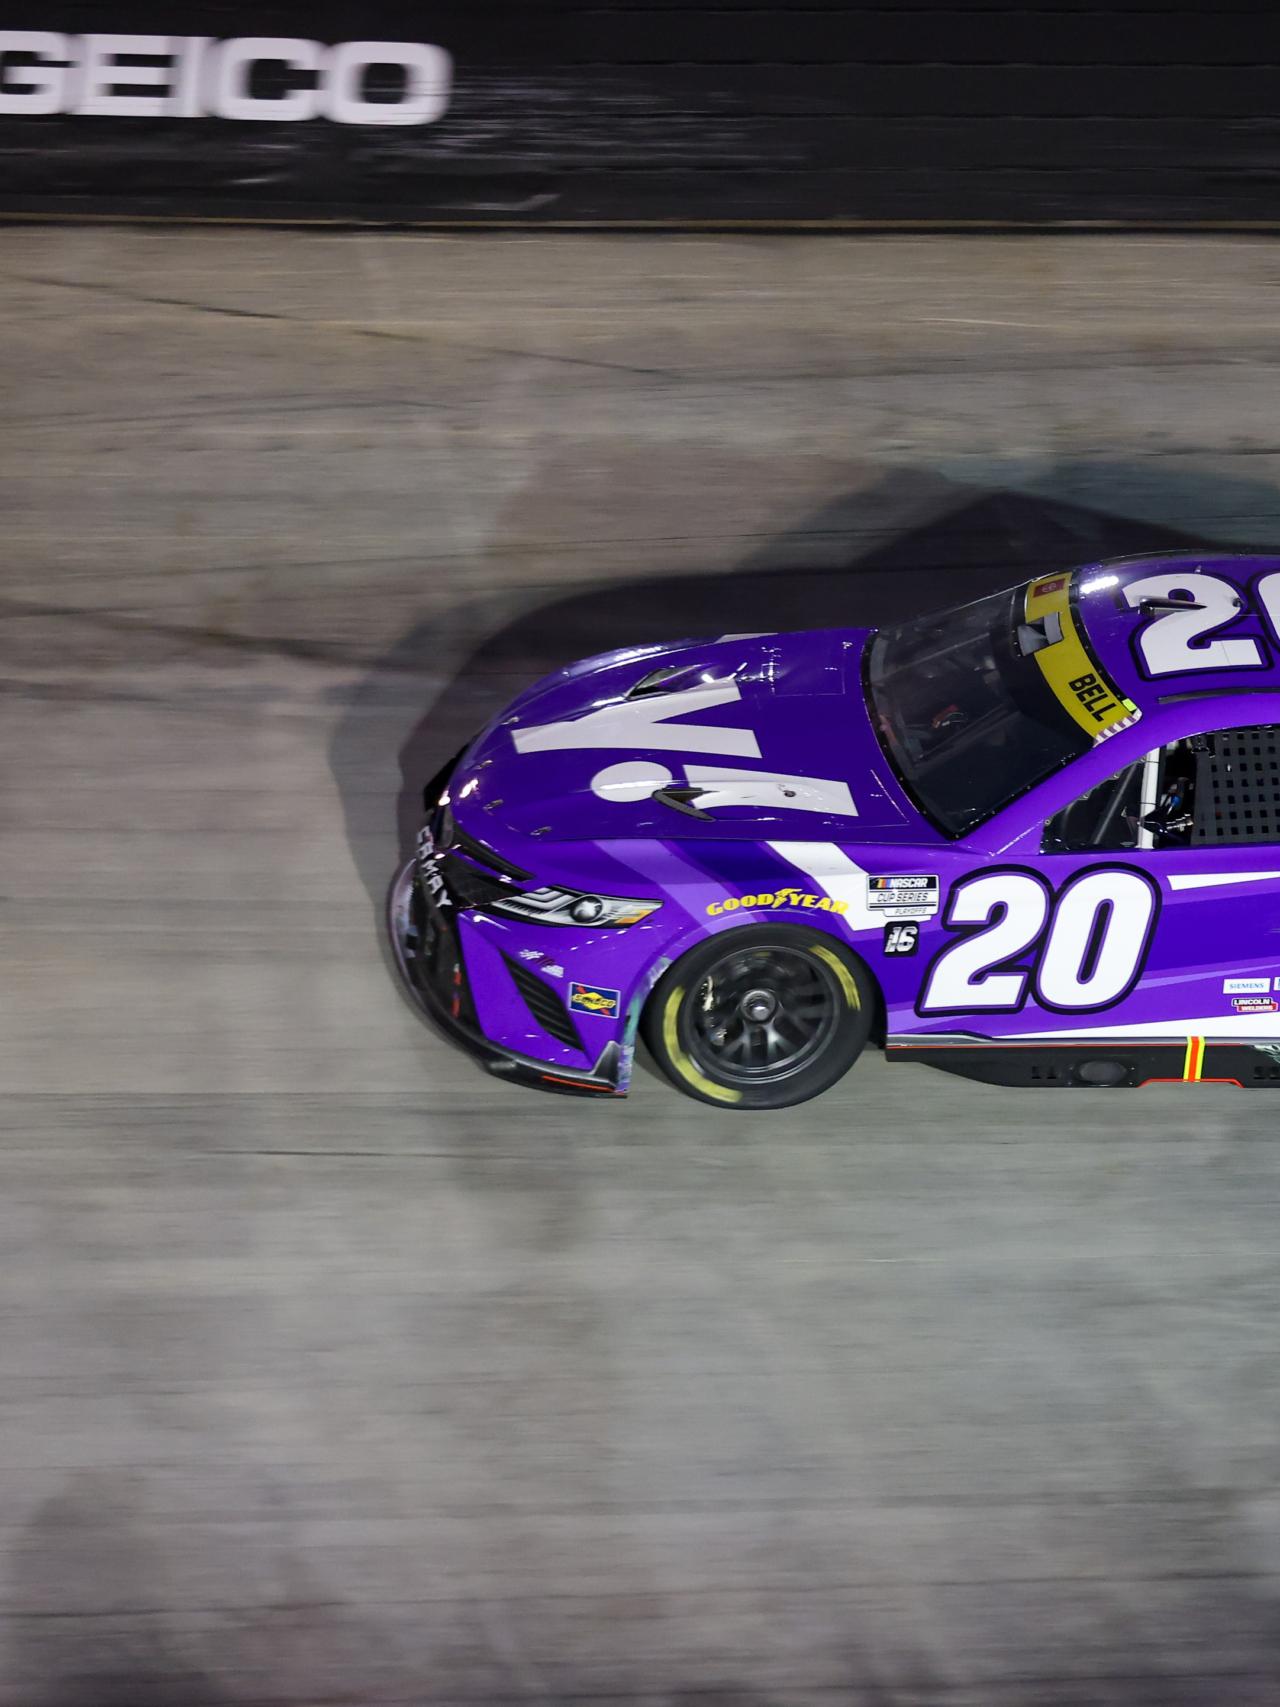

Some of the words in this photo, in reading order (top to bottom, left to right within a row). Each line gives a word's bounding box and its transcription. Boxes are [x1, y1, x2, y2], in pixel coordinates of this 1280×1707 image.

[0, 30, 454, 126] GEICO
[1068, 672, 1118, 723] BELL
[888, 877, 929, 888] NASCAR
[705, 887, 849, 916] GOODYEAR
[877, 892, 896, 902] CUP
[896, 892, 929, 902] SERIES
[885, 926, 918, 952] 16
[918, 867, 1158, 1013] 20
[1232, 998, 1271, 1006] LINCOLN
